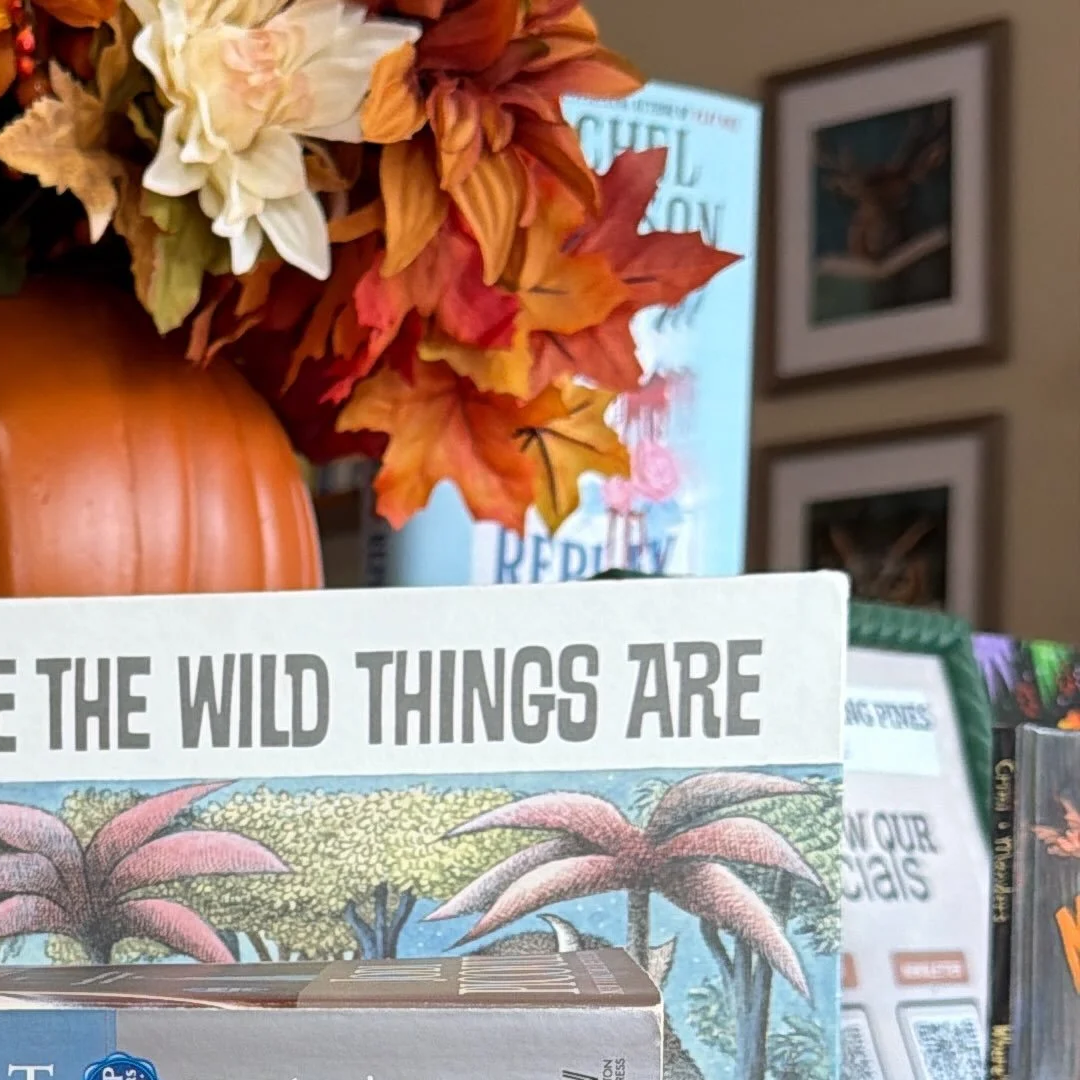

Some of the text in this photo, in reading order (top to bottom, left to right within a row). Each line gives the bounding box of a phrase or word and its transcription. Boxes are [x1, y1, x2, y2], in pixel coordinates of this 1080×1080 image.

[36, 655, 151, 751] THE
[178, 651, 330, 749] WILD
[354, 643, 599, 747] THINGS
[626, 639, 763, 738] ARE
[873, 811, 938, 853] OUR
